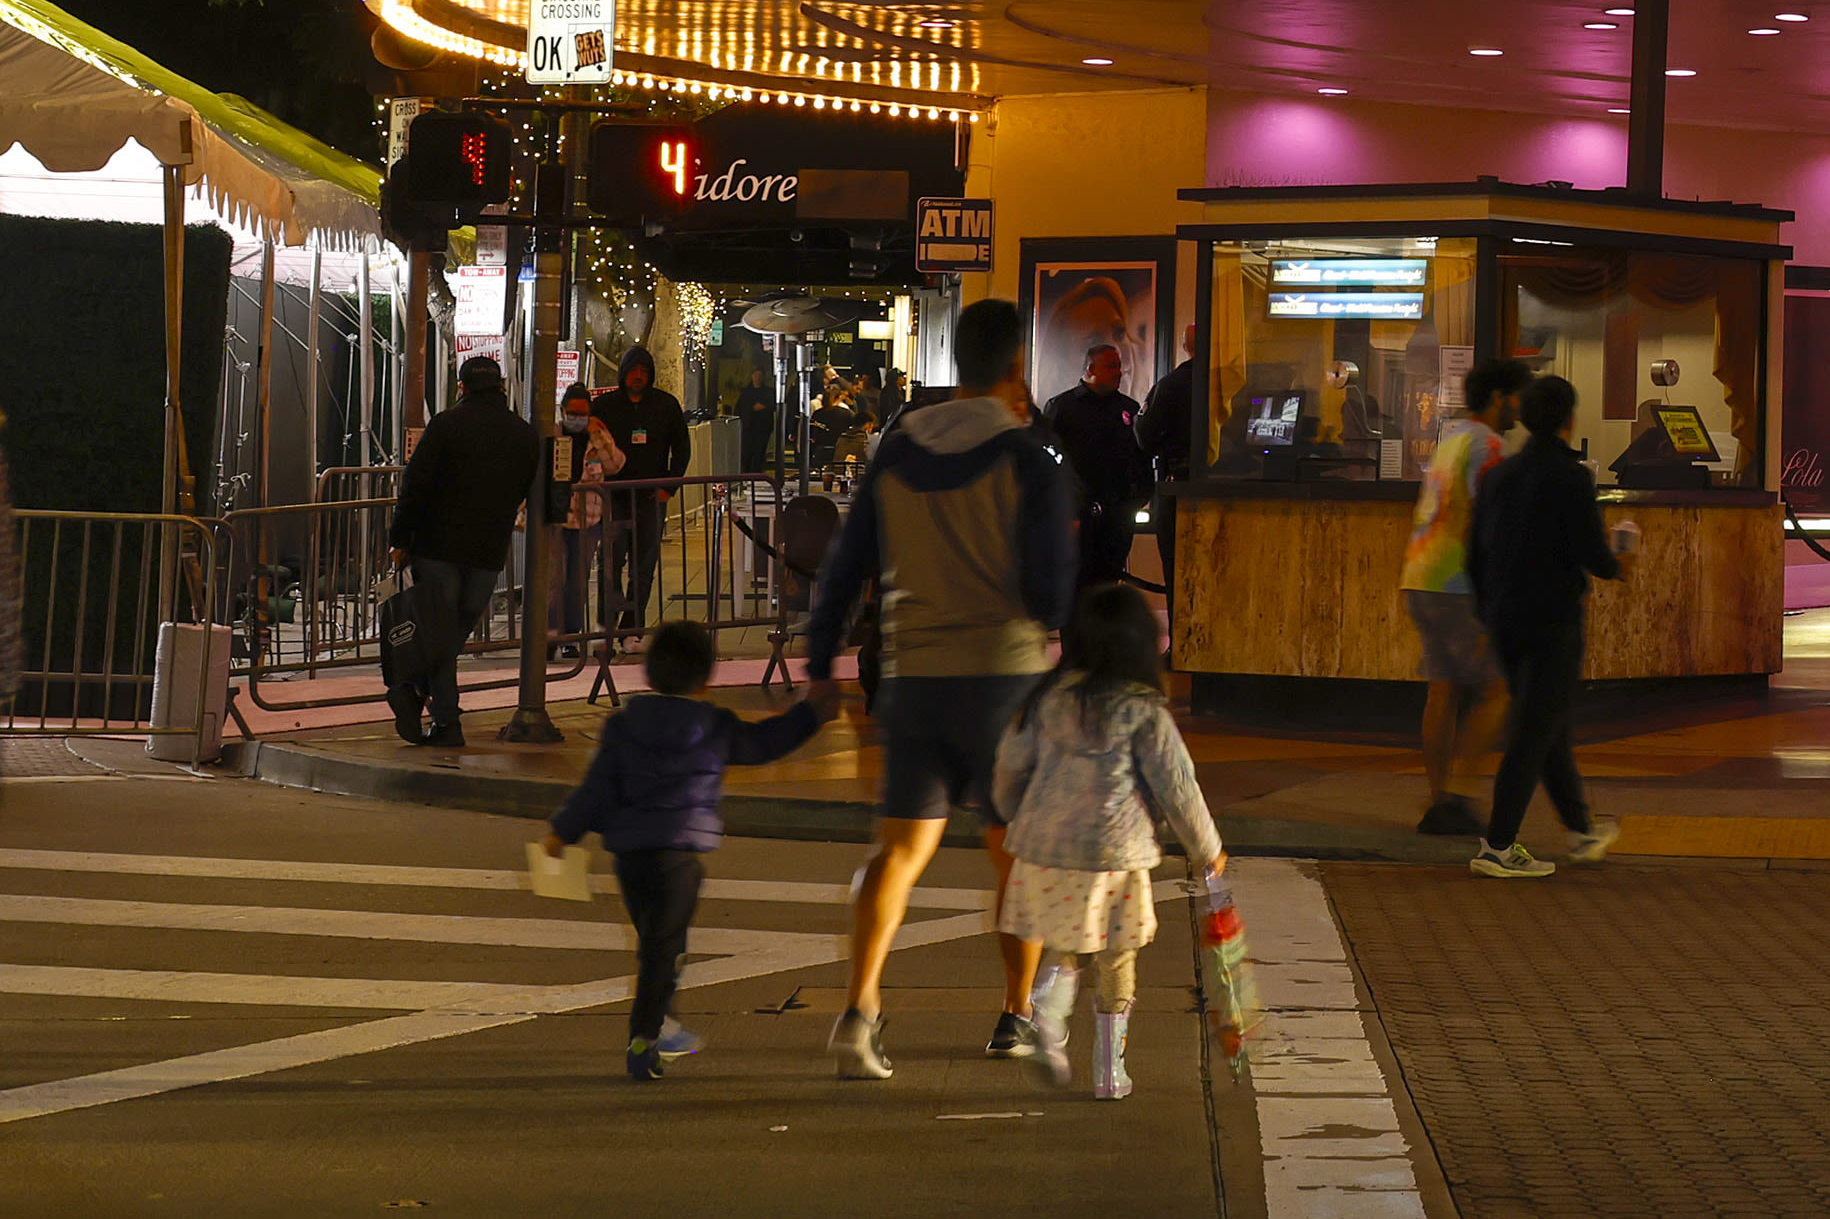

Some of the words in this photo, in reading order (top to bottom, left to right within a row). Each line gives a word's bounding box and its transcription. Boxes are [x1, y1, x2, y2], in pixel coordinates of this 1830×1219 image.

[541, 3, 601, 19] CROSSING
[533, 36, 562, 71] OK
[395, 102, 416, 117] CROSS
[660, 141, 686, 195] 4
[920, 209, 991, 238] ATM
[459, 336, 472, 351] NO
